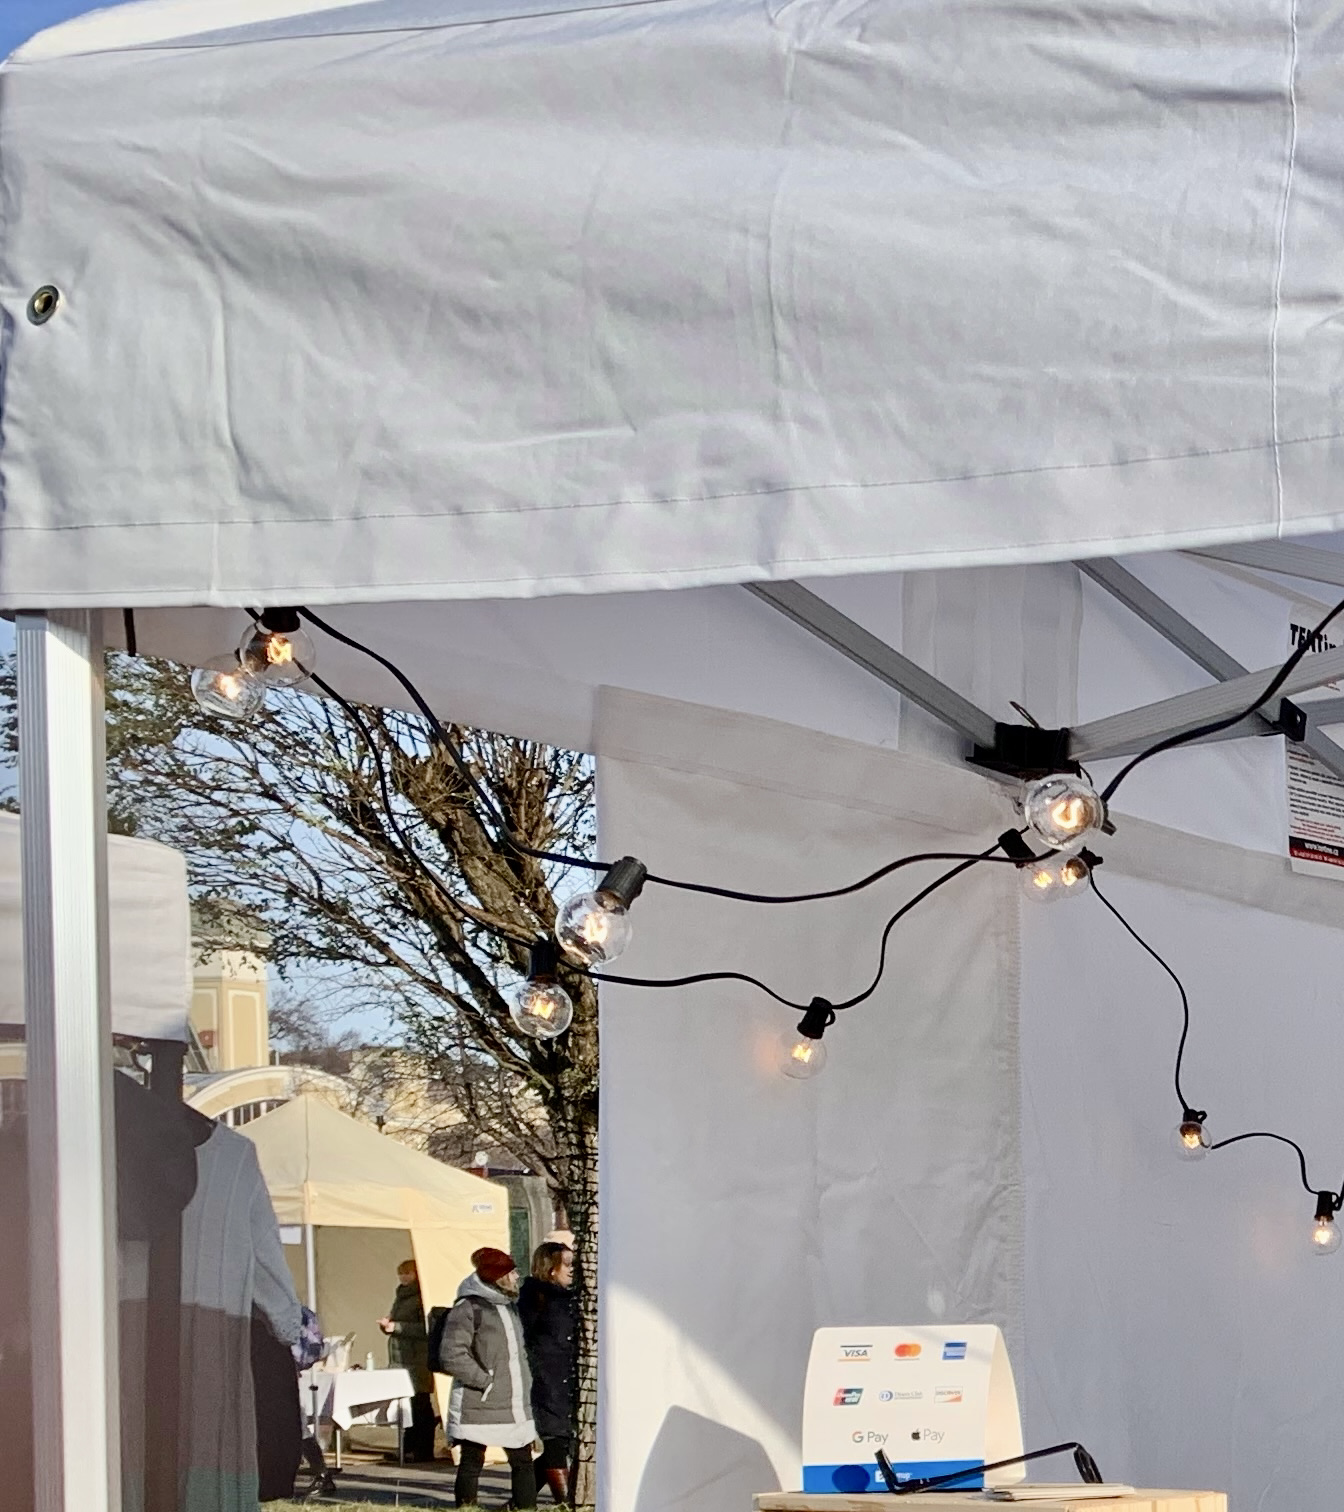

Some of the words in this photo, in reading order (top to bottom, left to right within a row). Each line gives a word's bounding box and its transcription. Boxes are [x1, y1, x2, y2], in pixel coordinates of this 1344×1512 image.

[843, 1349, 868, 1357] VISA
[867, 1431, 889, 1445] Pay
[923, 1428, 945, 1444] Pay
